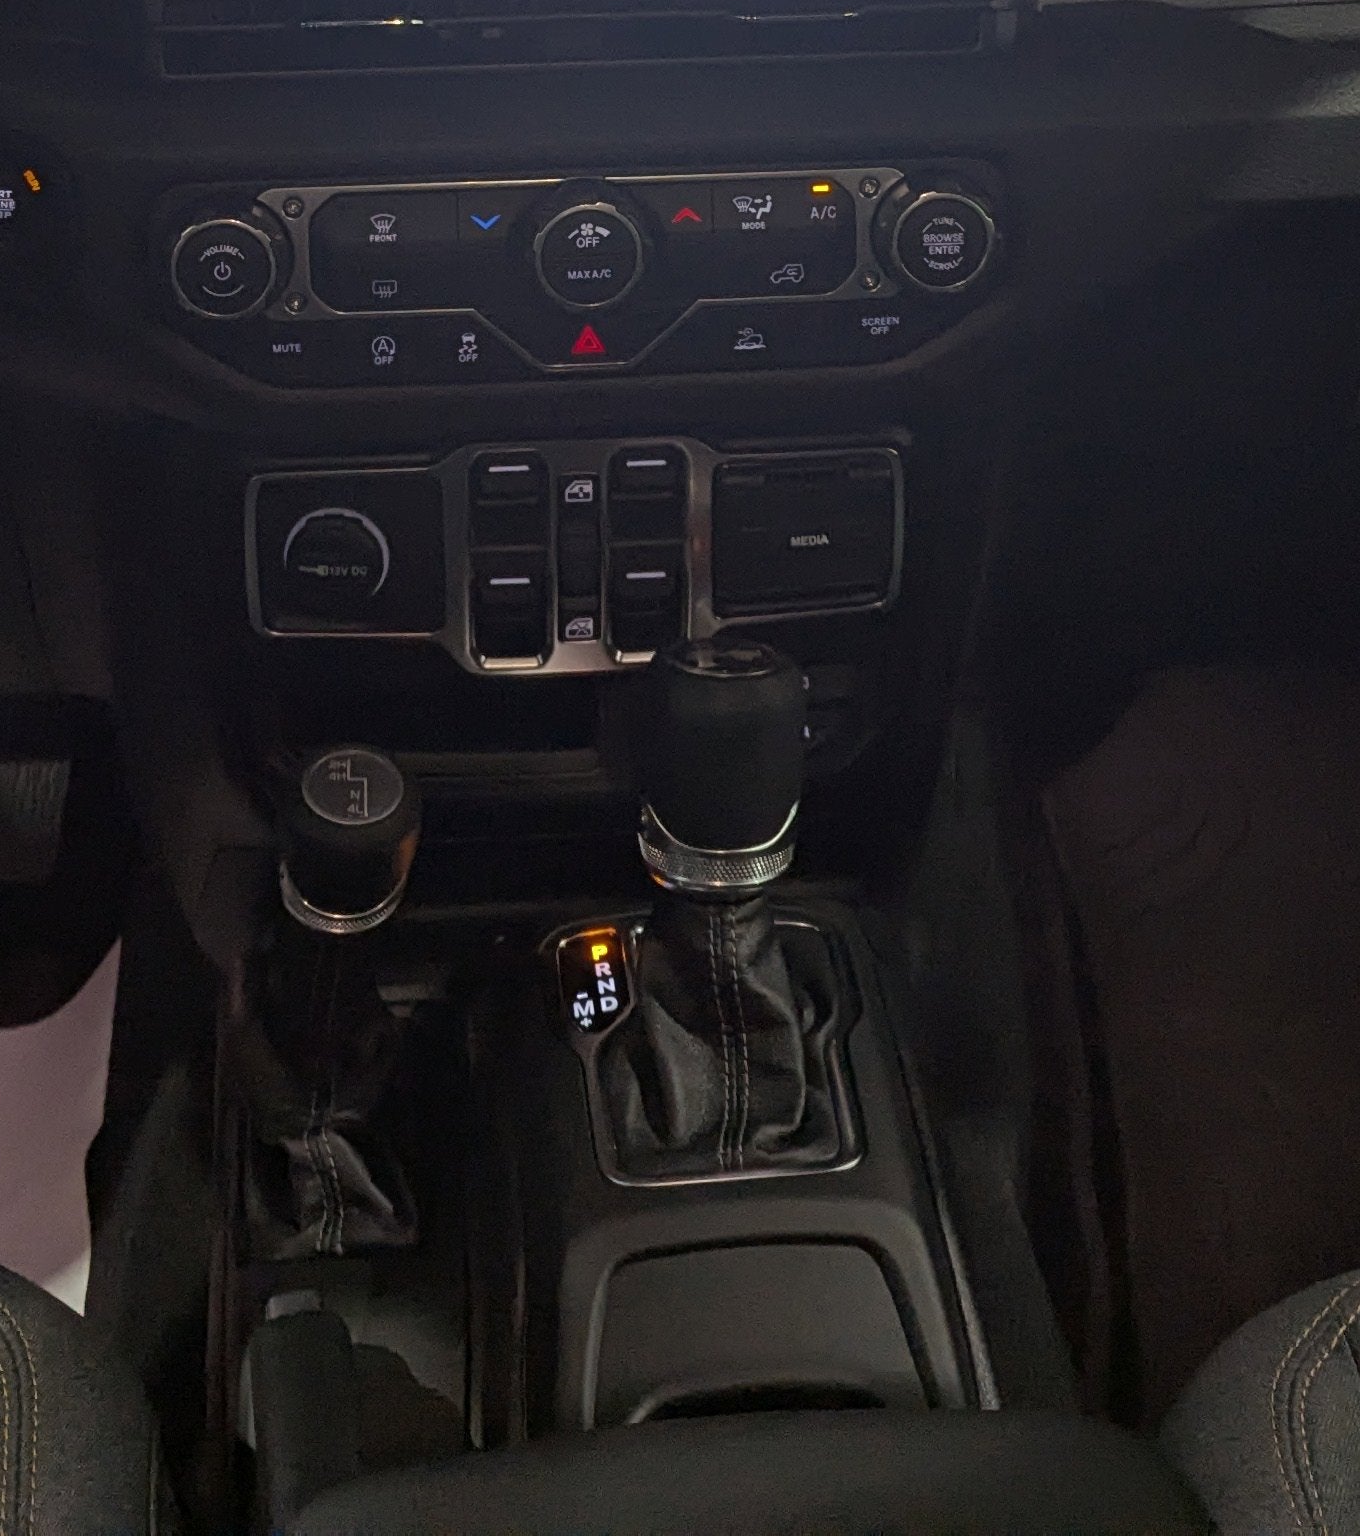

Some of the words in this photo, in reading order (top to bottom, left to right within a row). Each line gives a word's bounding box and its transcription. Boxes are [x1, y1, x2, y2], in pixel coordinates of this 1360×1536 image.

[23, 169, 42, 193] RUN
[810, 204, 838, 221] A/C
[741, 220, 767, 231] MODE
[932, 216, 956, 228] TUNE
[368, 233, 398, 243] FRONT
[575, 236, 601, 249] OFF
[922, 232, 965, 244] BROWSE
[203, 244, 241, 258] VOLUME
[927, 244, 962, 256] ENTER
[927, 257, 962, 272] SCROLL
[566, 269, 591, 281] MAX
[590, 267, 613, 280] A/C
[860, 316, 901, 328] SCREEN
[869, 324, 890, 336] OFF
[271, 343, 302, 354] MUTE
[373, 355, 395, 365] OFF
[457, 353, 479, 363] OFF
[789, 533, 830, 548] MEDIA
[591, 944, 609, 961] P
[594, 961, 613, 977] R
[597, 977, 616, 994] N
[572, 999, 596, 1017] M
[599, 995, 619, 1013] D
